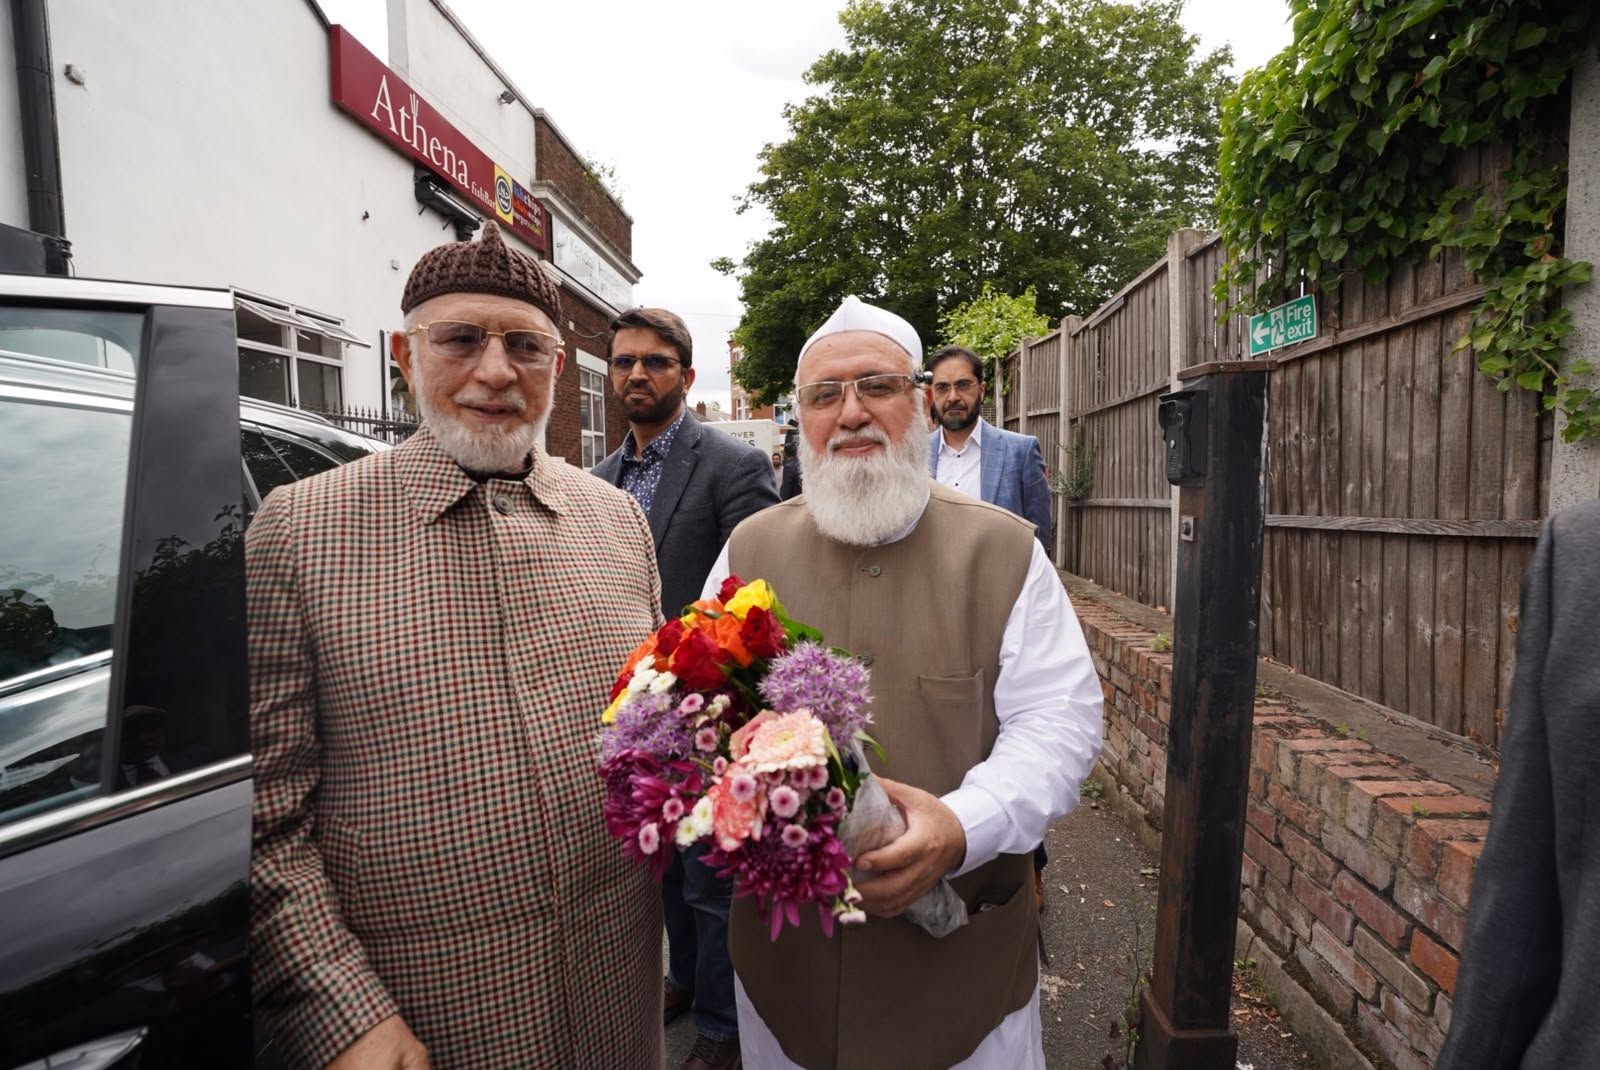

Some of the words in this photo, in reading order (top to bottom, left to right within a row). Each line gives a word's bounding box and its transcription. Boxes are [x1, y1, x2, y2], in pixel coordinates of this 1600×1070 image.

[370, 73, 470, 189] Athena
[1286, 304, 1312, 323] Fire
[1287, 318, 1312, 339] exit
